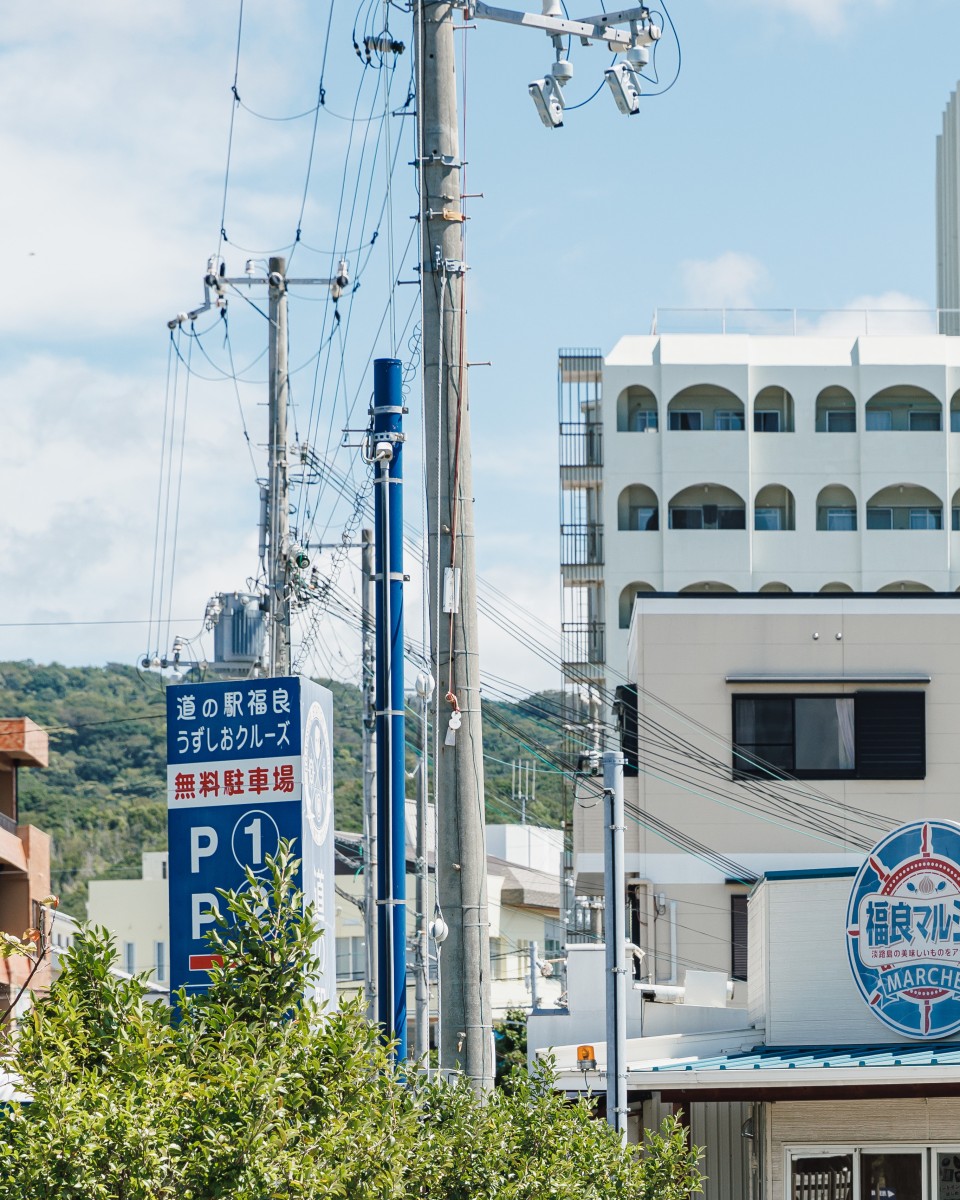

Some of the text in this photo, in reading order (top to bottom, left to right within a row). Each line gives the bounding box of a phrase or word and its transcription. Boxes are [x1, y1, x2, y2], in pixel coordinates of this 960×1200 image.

[176, 687, 291, 720] 道の駅福良
[176, 720, 291, 754] うずしおクルーズ
[174, 764, 294, 800] 無料駐車場
[190, 826, 218, 873] P
[191, 893, 220, 939] P
